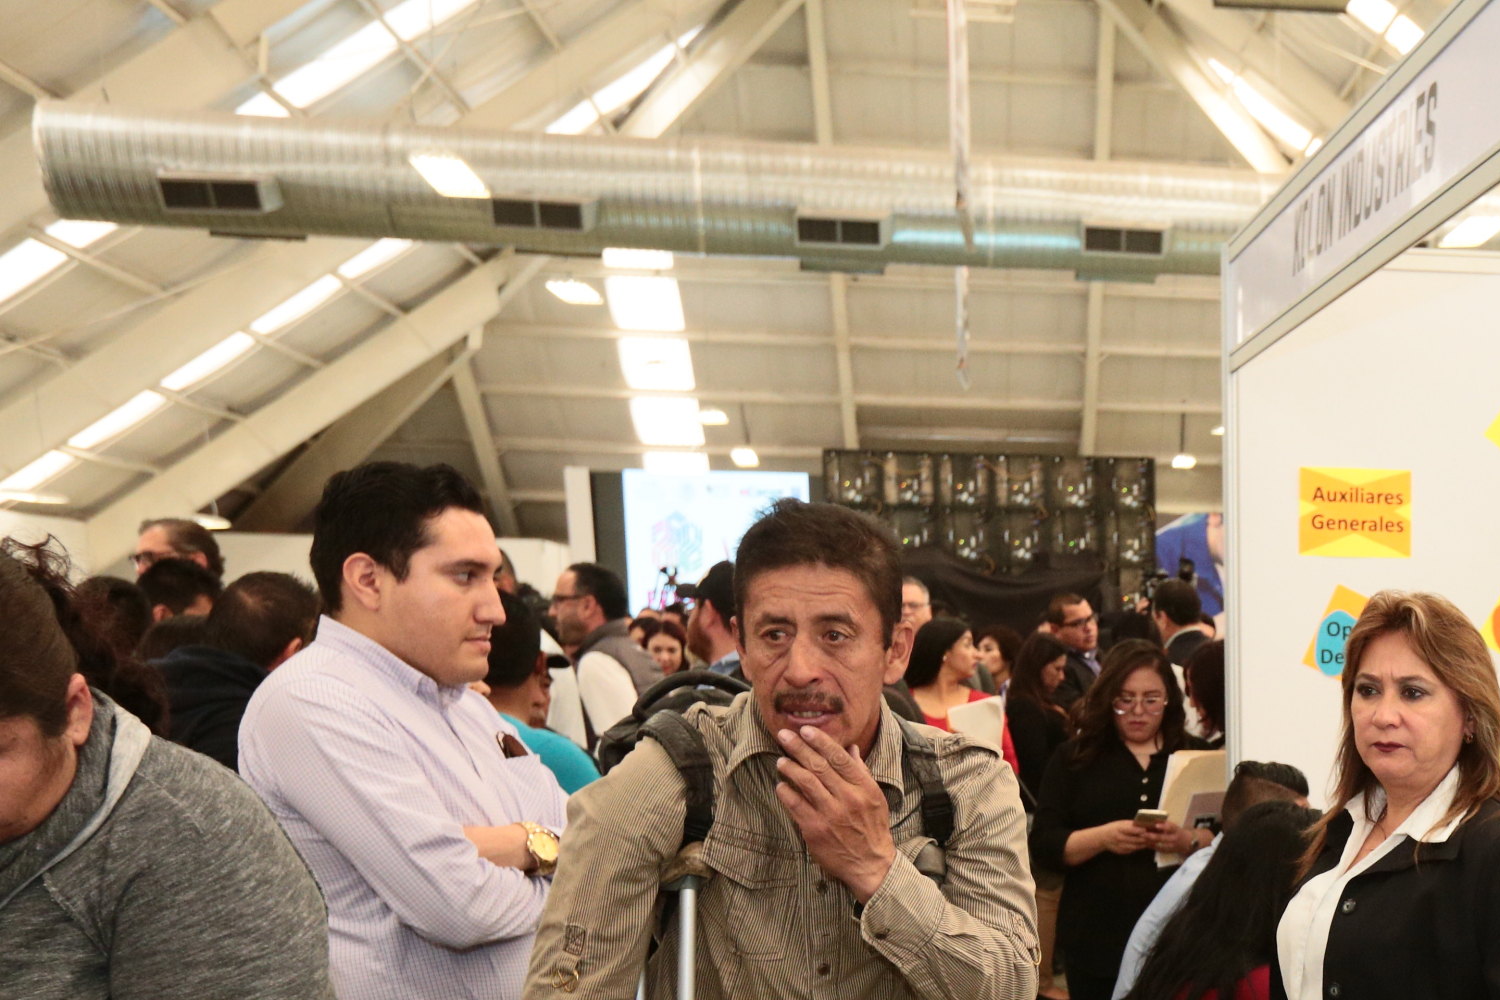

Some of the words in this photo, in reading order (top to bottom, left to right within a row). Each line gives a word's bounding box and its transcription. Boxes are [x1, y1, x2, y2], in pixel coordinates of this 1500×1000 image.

[1339, 81, 1438, 240] INDUSTRIES
[1312, 486, 1404, 506] Auxiliares
[1311, 513, 1405, 534] Generales
